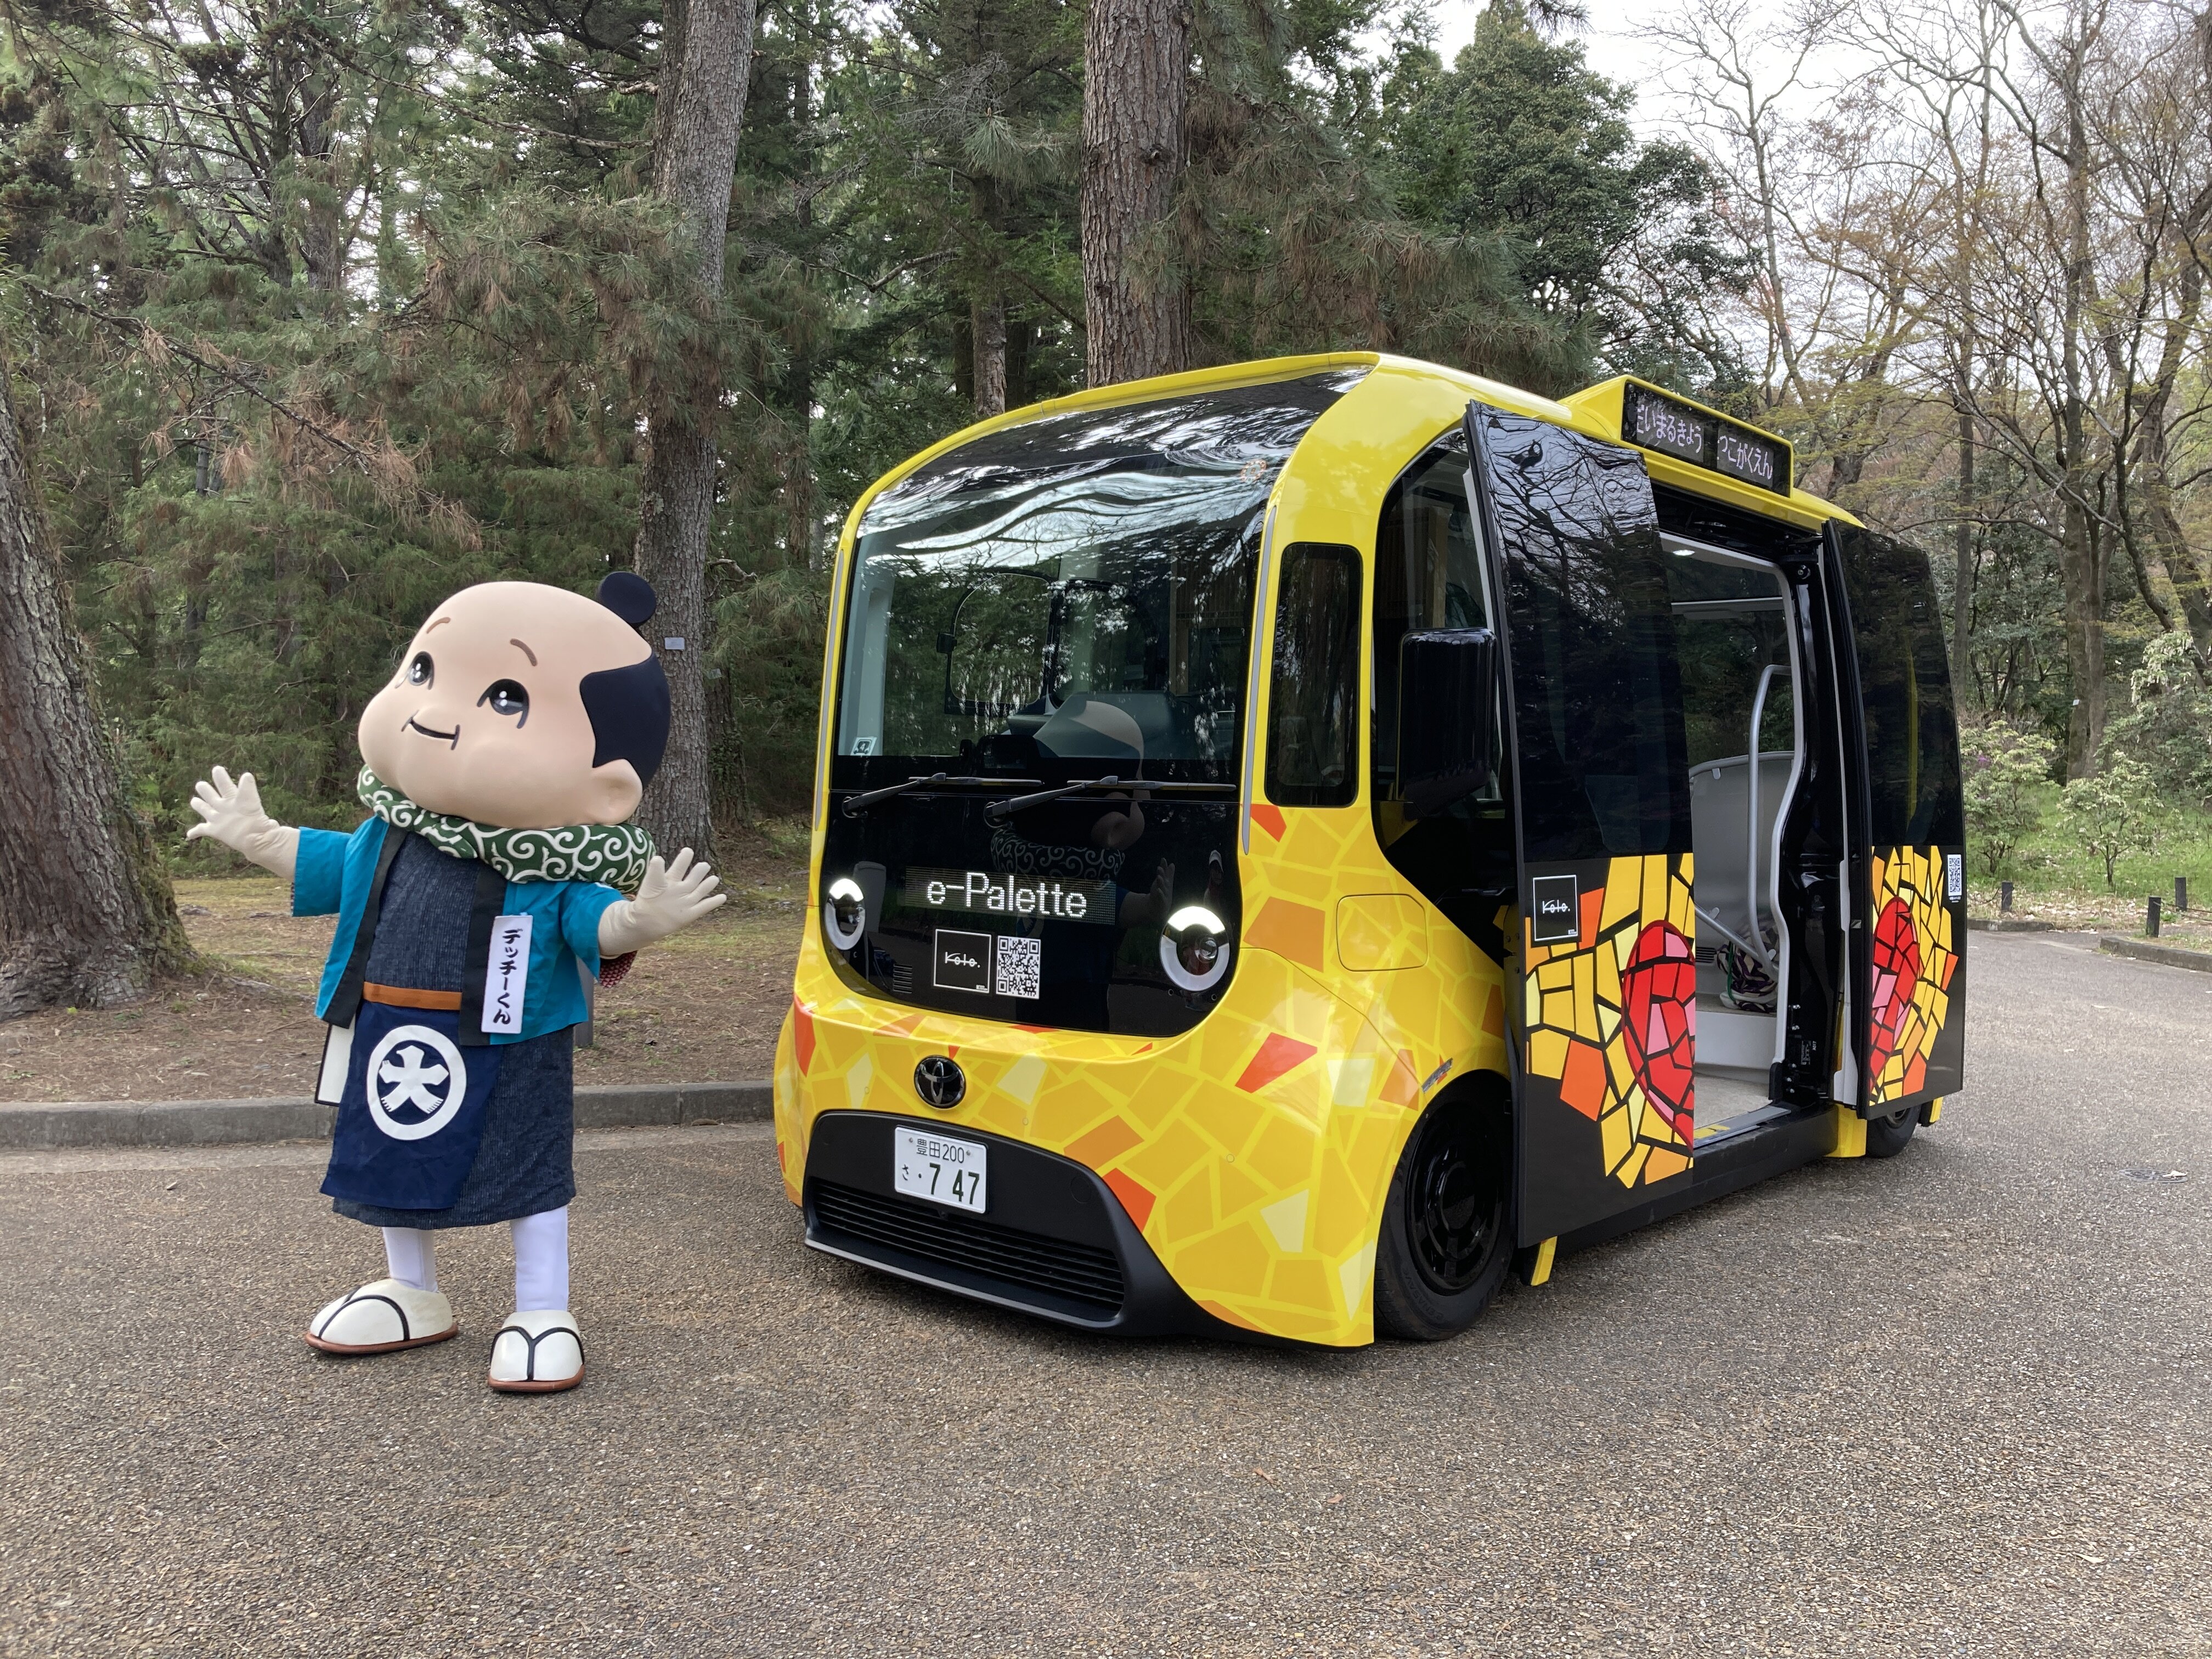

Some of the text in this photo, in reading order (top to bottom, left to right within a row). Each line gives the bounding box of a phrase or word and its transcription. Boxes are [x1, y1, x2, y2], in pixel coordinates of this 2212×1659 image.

[1717, 435, 1773, 480] っこがくえん
[927, 872, 1087, 918] e-Palette
[493, 928, 523, 1025] デッチーくん
